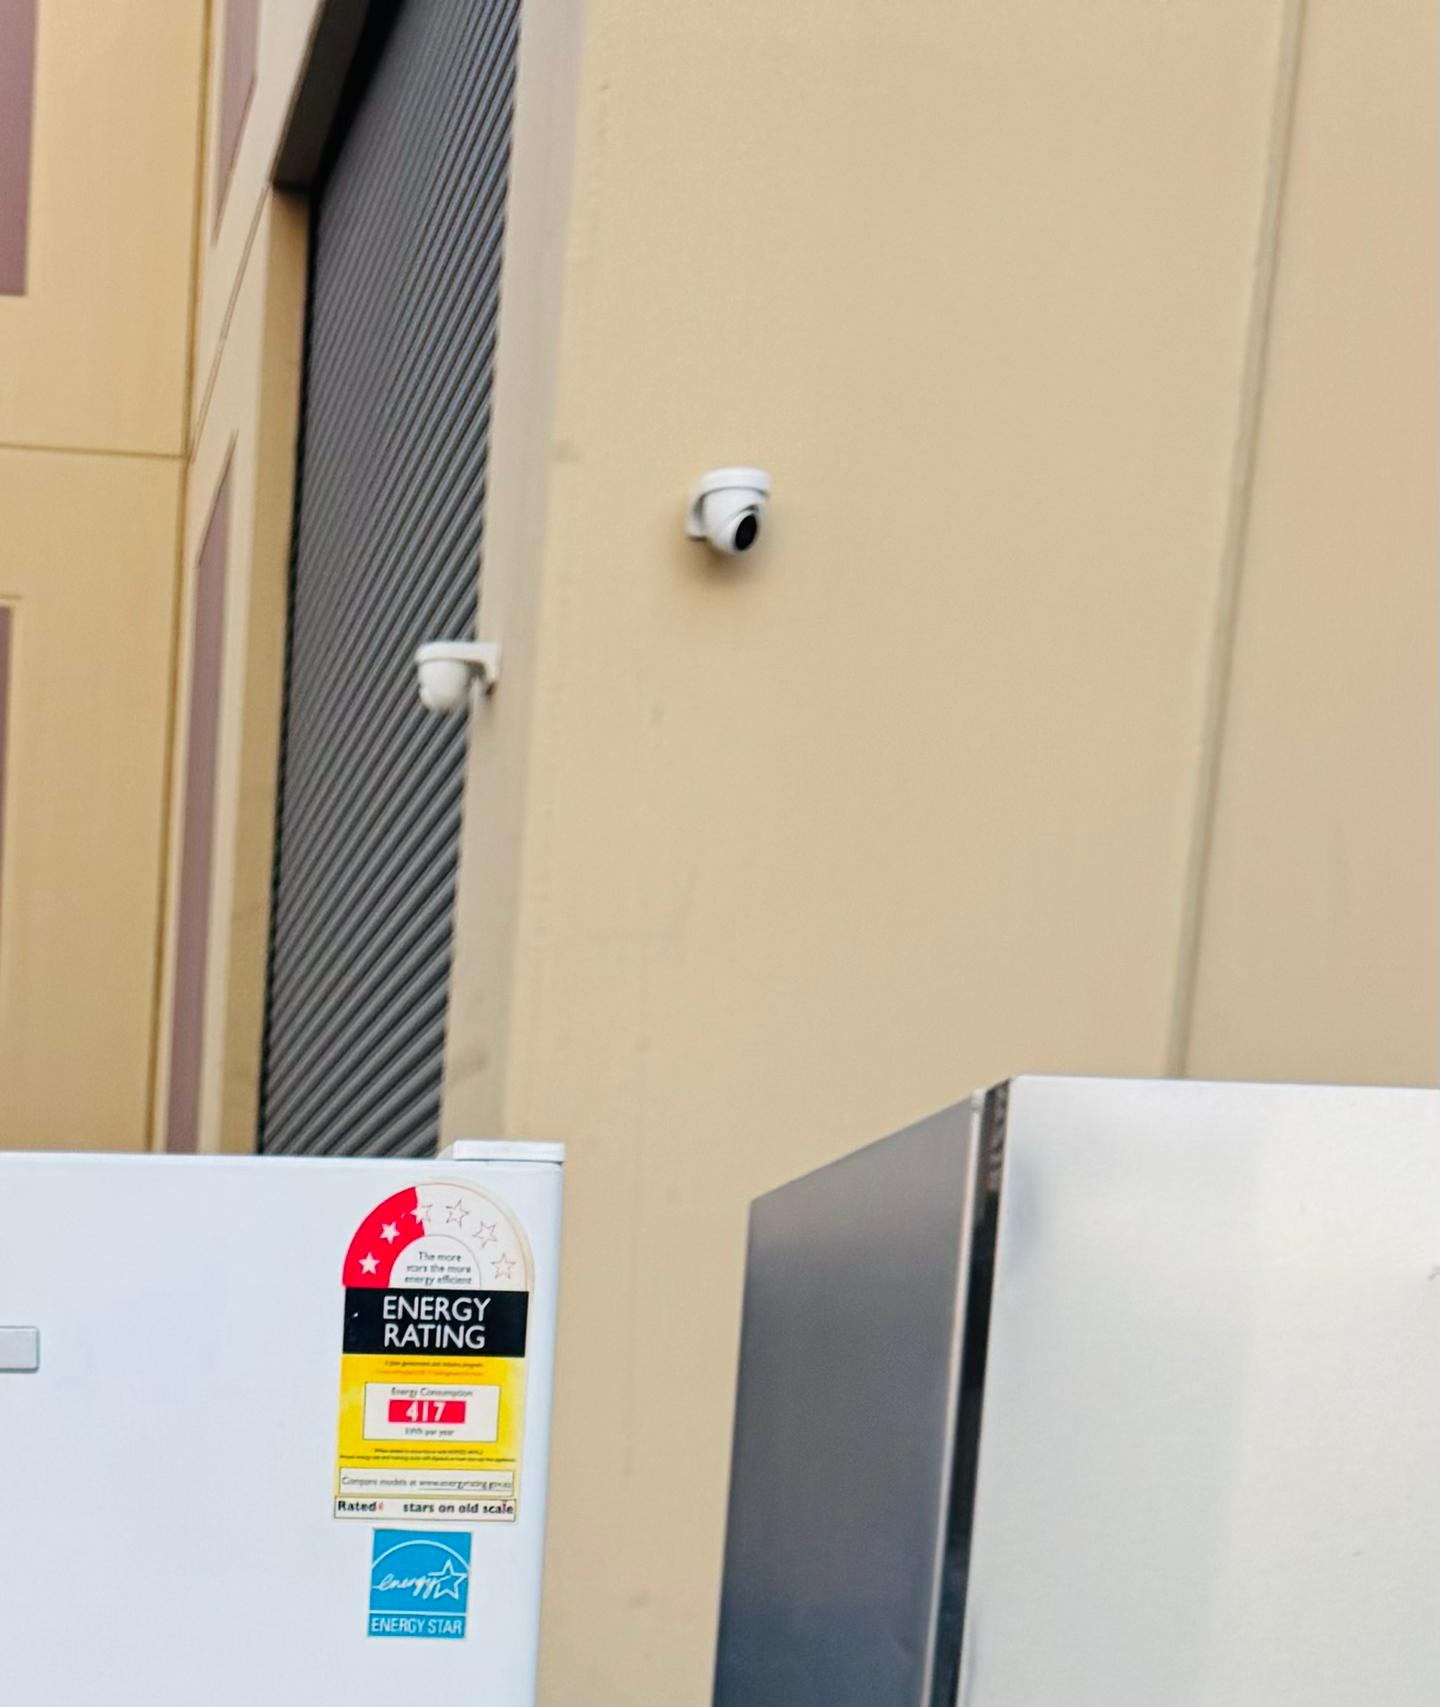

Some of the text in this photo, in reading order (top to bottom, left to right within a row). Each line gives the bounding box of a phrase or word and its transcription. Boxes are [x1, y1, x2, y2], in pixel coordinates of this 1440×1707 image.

[418, 1251, 462, 1262] The more
[406, 1264, 471, 1274] stars the more
[404, 1274, 472, 1286] energy efficient
[382, 1295, 491, 1322] ENERGY
[384, 1323, 486, 1349] RATING
[391, 1387, 473, 1399] Energy Consumption
[405, 1401, 447, 1422] 417
[337, 1500, 377, 1512] Rated
[403, 1502, 434, 1513] stars
[438, 1505, 455, 1514] on
[459, 1502, 479, 1514] old
[483, 1503, 514, 1515] scale
[371, 1617, 462, 1635] ENERGY STAR
